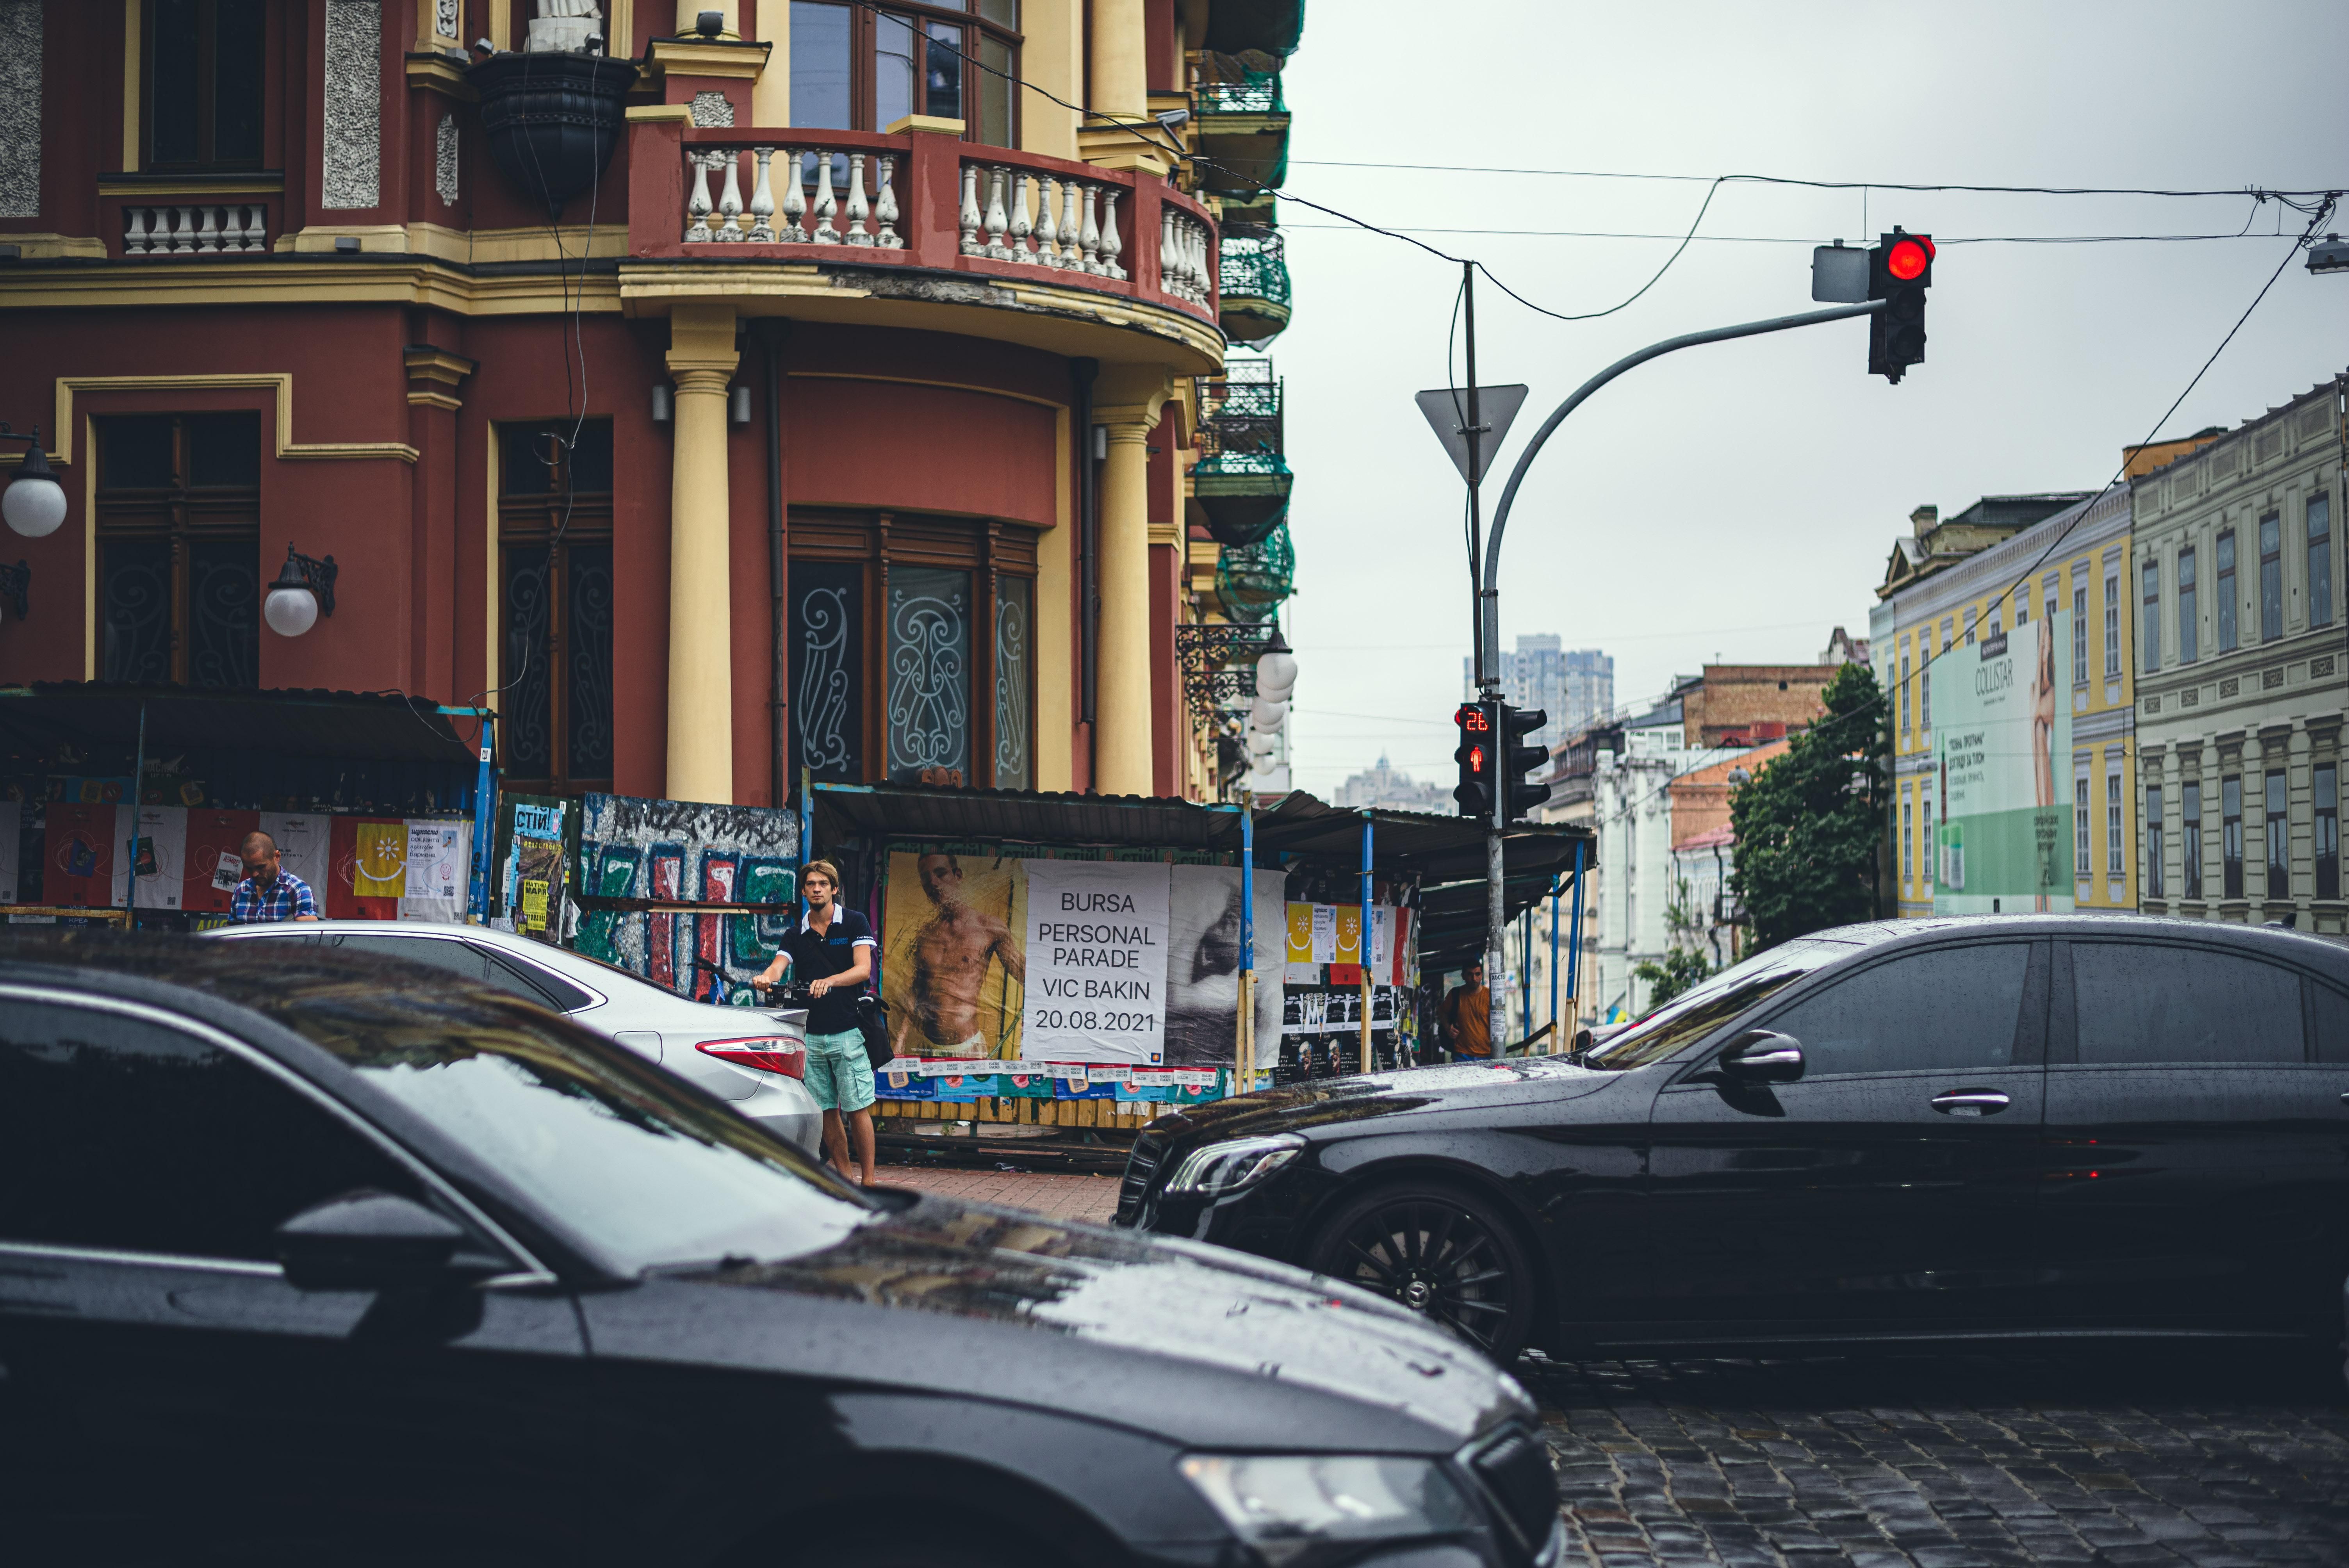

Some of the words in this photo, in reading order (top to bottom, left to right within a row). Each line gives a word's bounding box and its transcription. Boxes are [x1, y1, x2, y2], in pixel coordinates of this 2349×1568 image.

[1975, 657, 2013, 697] COLLISTAR
[1467, 712, 1488, 731] 26
[517, 806, 551, 831] СТІЙ!
[526, 887, 546, 895] МАРІЯ
[1061, 893, 1135, 912] BURSA
[1039, 923, 1155, 946] PERSONAL
[1054, 949, 1139, 968] PARADE
[1043, 978, 1079, 997] VIC
[1085, 980, 1150, 1000] BAKIN
[1035, 1010, 1154, 1032] 20.08.2021
